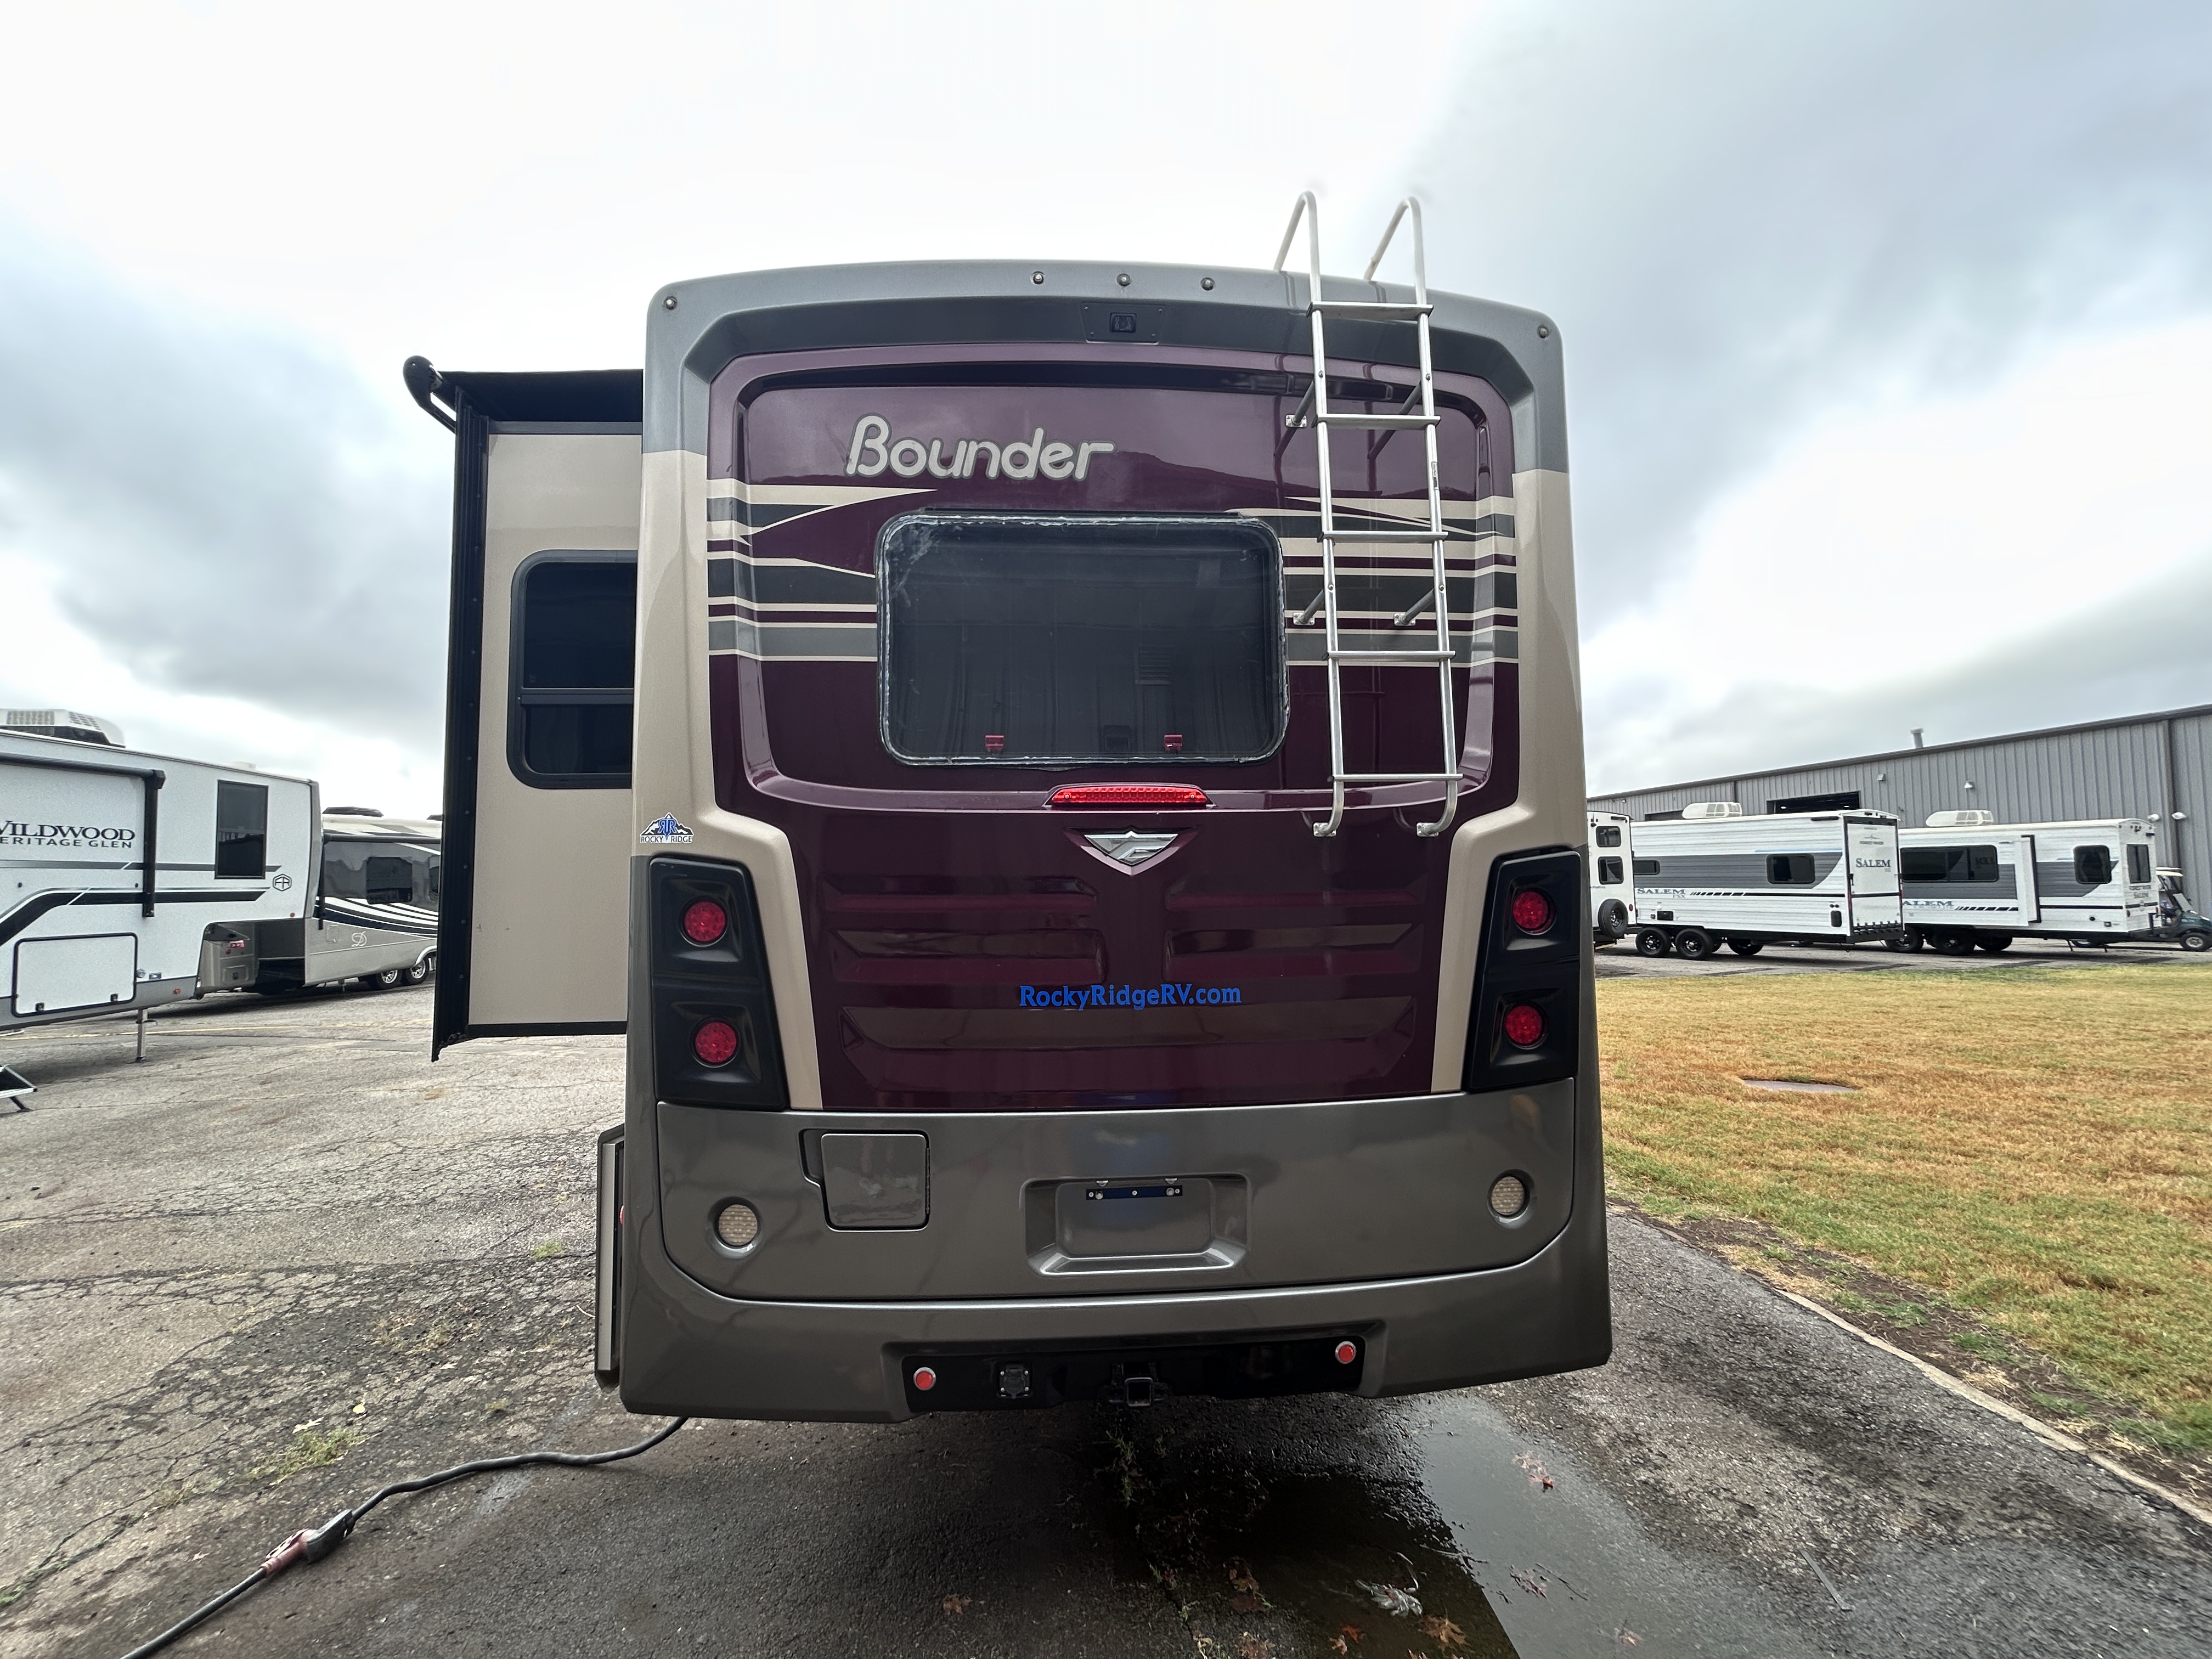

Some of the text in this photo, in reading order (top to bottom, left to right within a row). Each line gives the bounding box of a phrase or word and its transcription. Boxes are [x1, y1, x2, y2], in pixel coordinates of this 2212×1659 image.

[843, 413, 1117, 481] Bounder
[0, 837, 132, 848] ERITAGE GLEN
[1856, 858, 1891, 868] SALEM
[1019, 983, 1242, 1011] RockyRidgeRV.com
